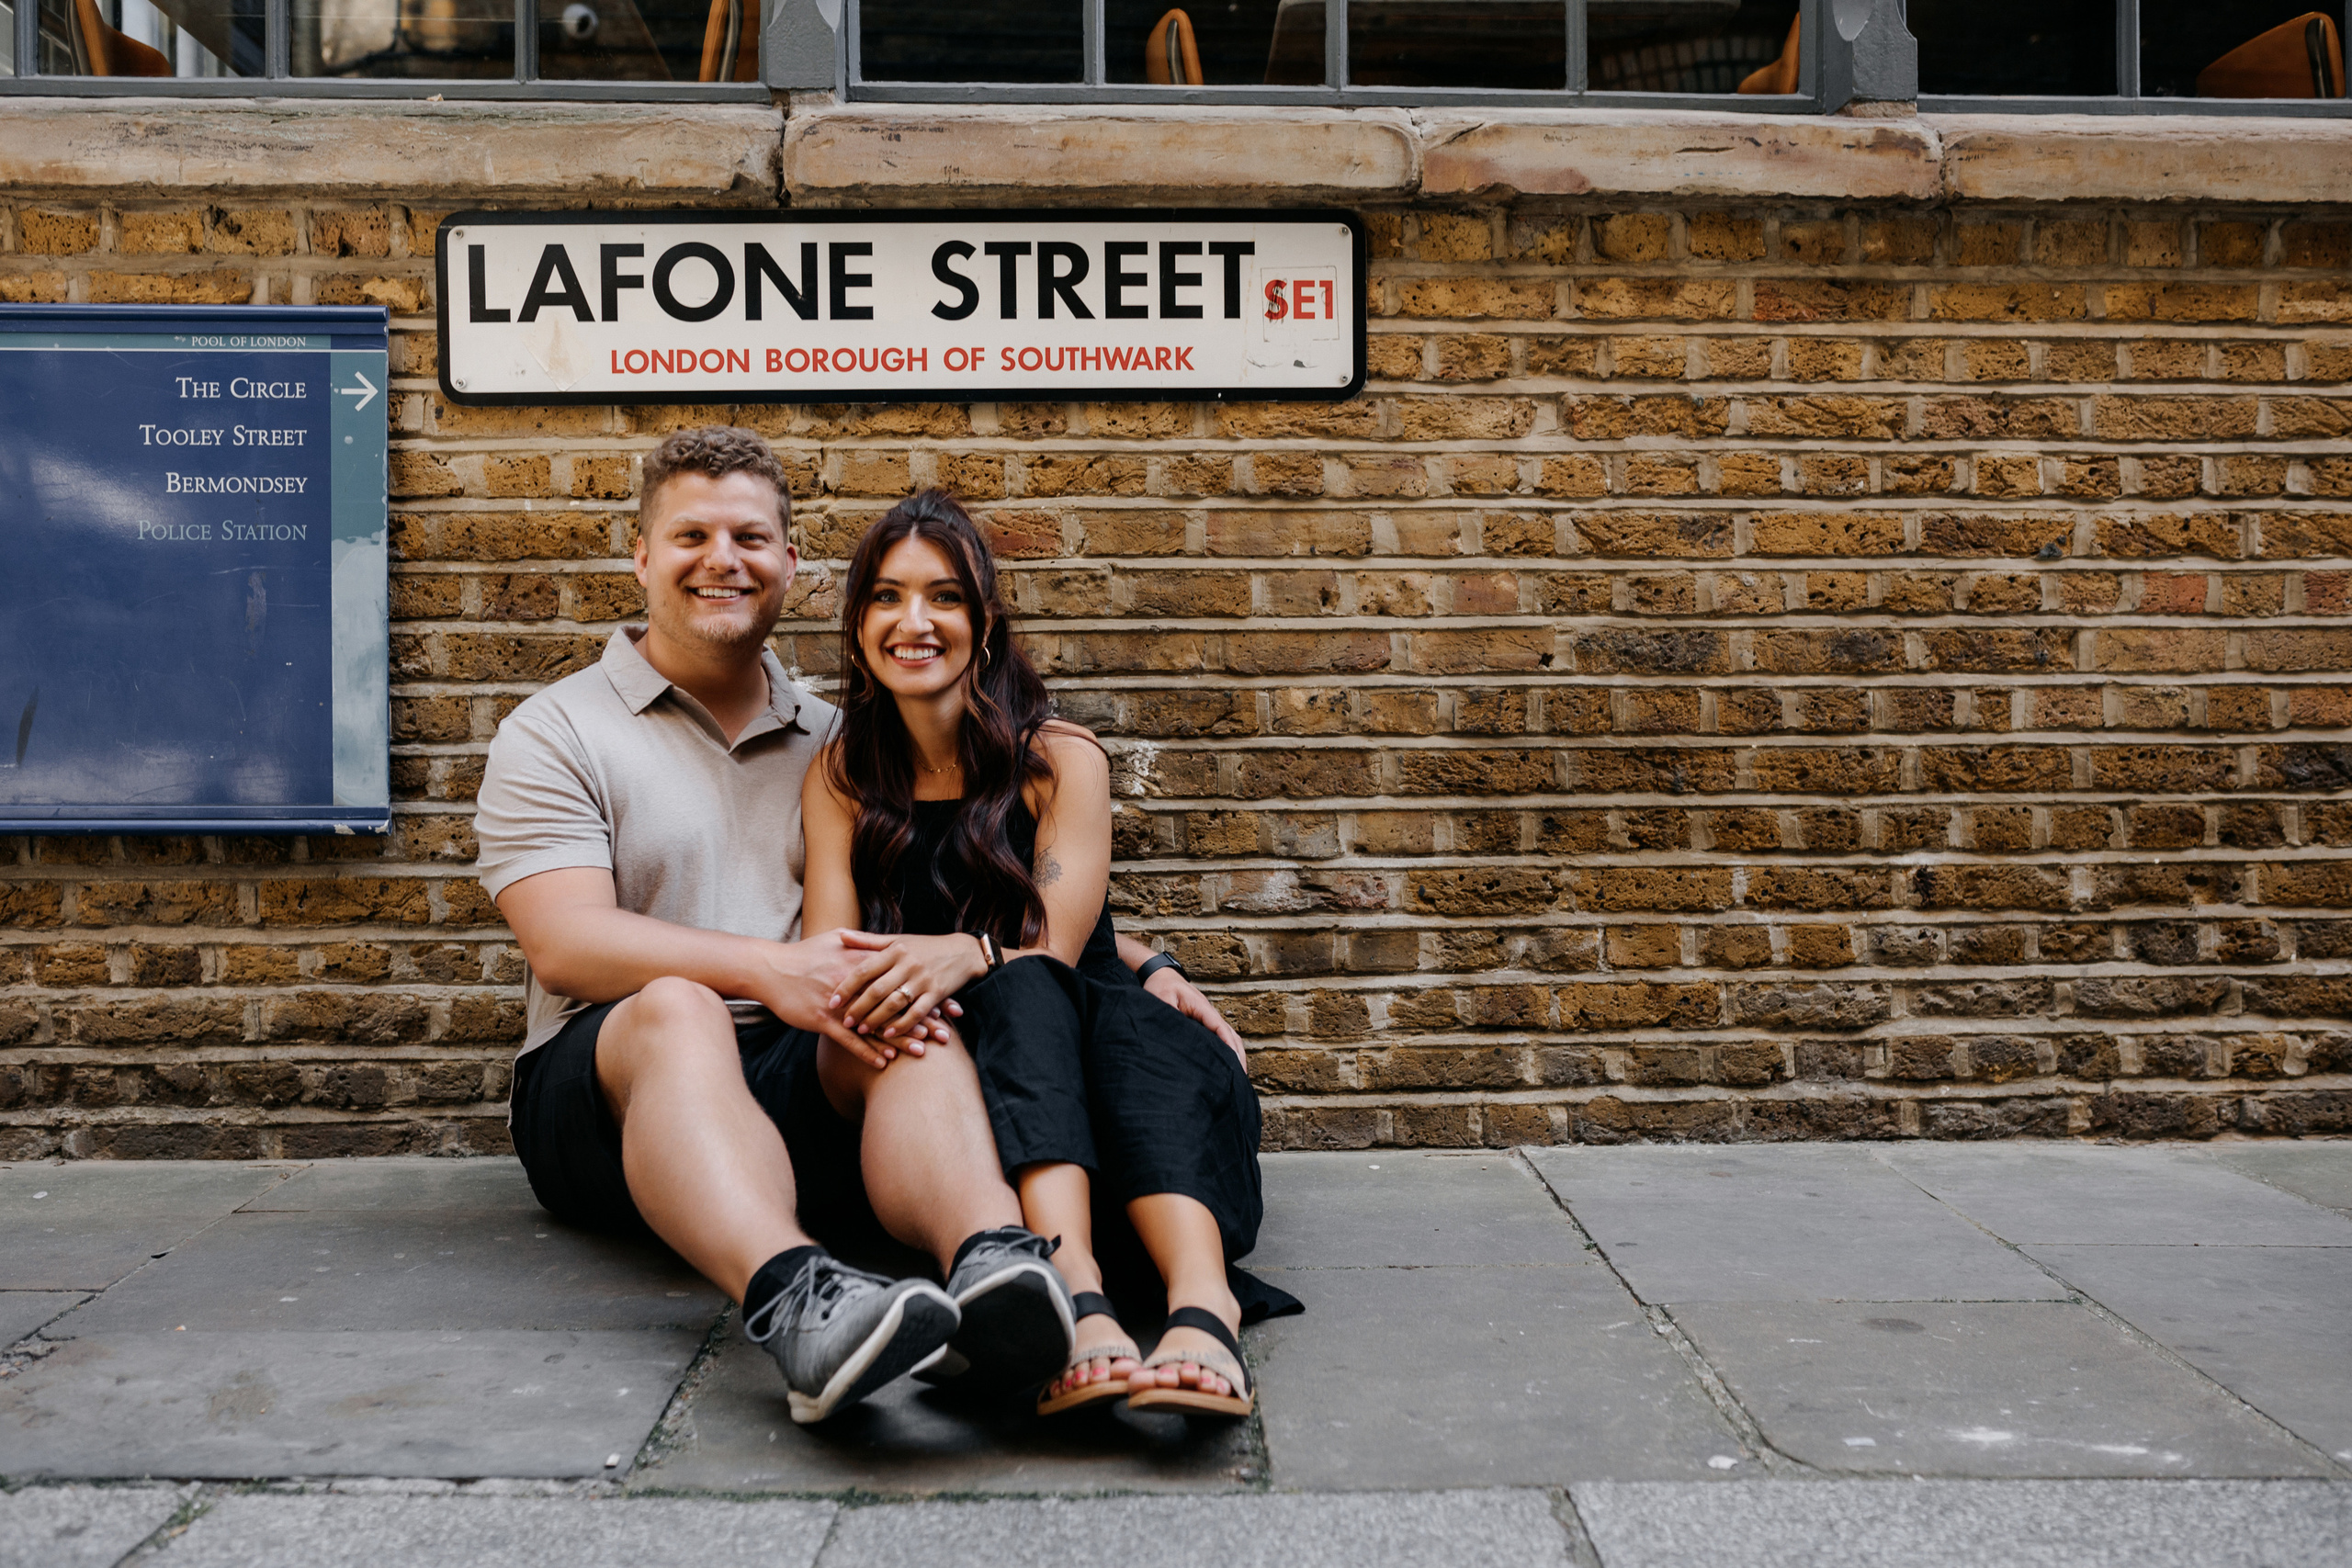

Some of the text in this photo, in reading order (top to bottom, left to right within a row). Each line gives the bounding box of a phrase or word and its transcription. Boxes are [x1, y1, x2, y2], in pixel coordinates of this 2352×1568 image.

[468, 240, 1256, 322] LAFONE STREET
[1263, 279, 1334, 321] SE1
[191, 335, 307, 348] POOL OF LONDON
[611, 346, 1195, 374] LONDON BOROUGH OF SOUTHWARK
[175, 377, 307, 399] THE CIRCLE
[139, 424, 308, 446] TOOLEY STREET
[165, 471, 309, 493] BERMONDSEY
[137, 520, 307, 541] POLICE STATION
